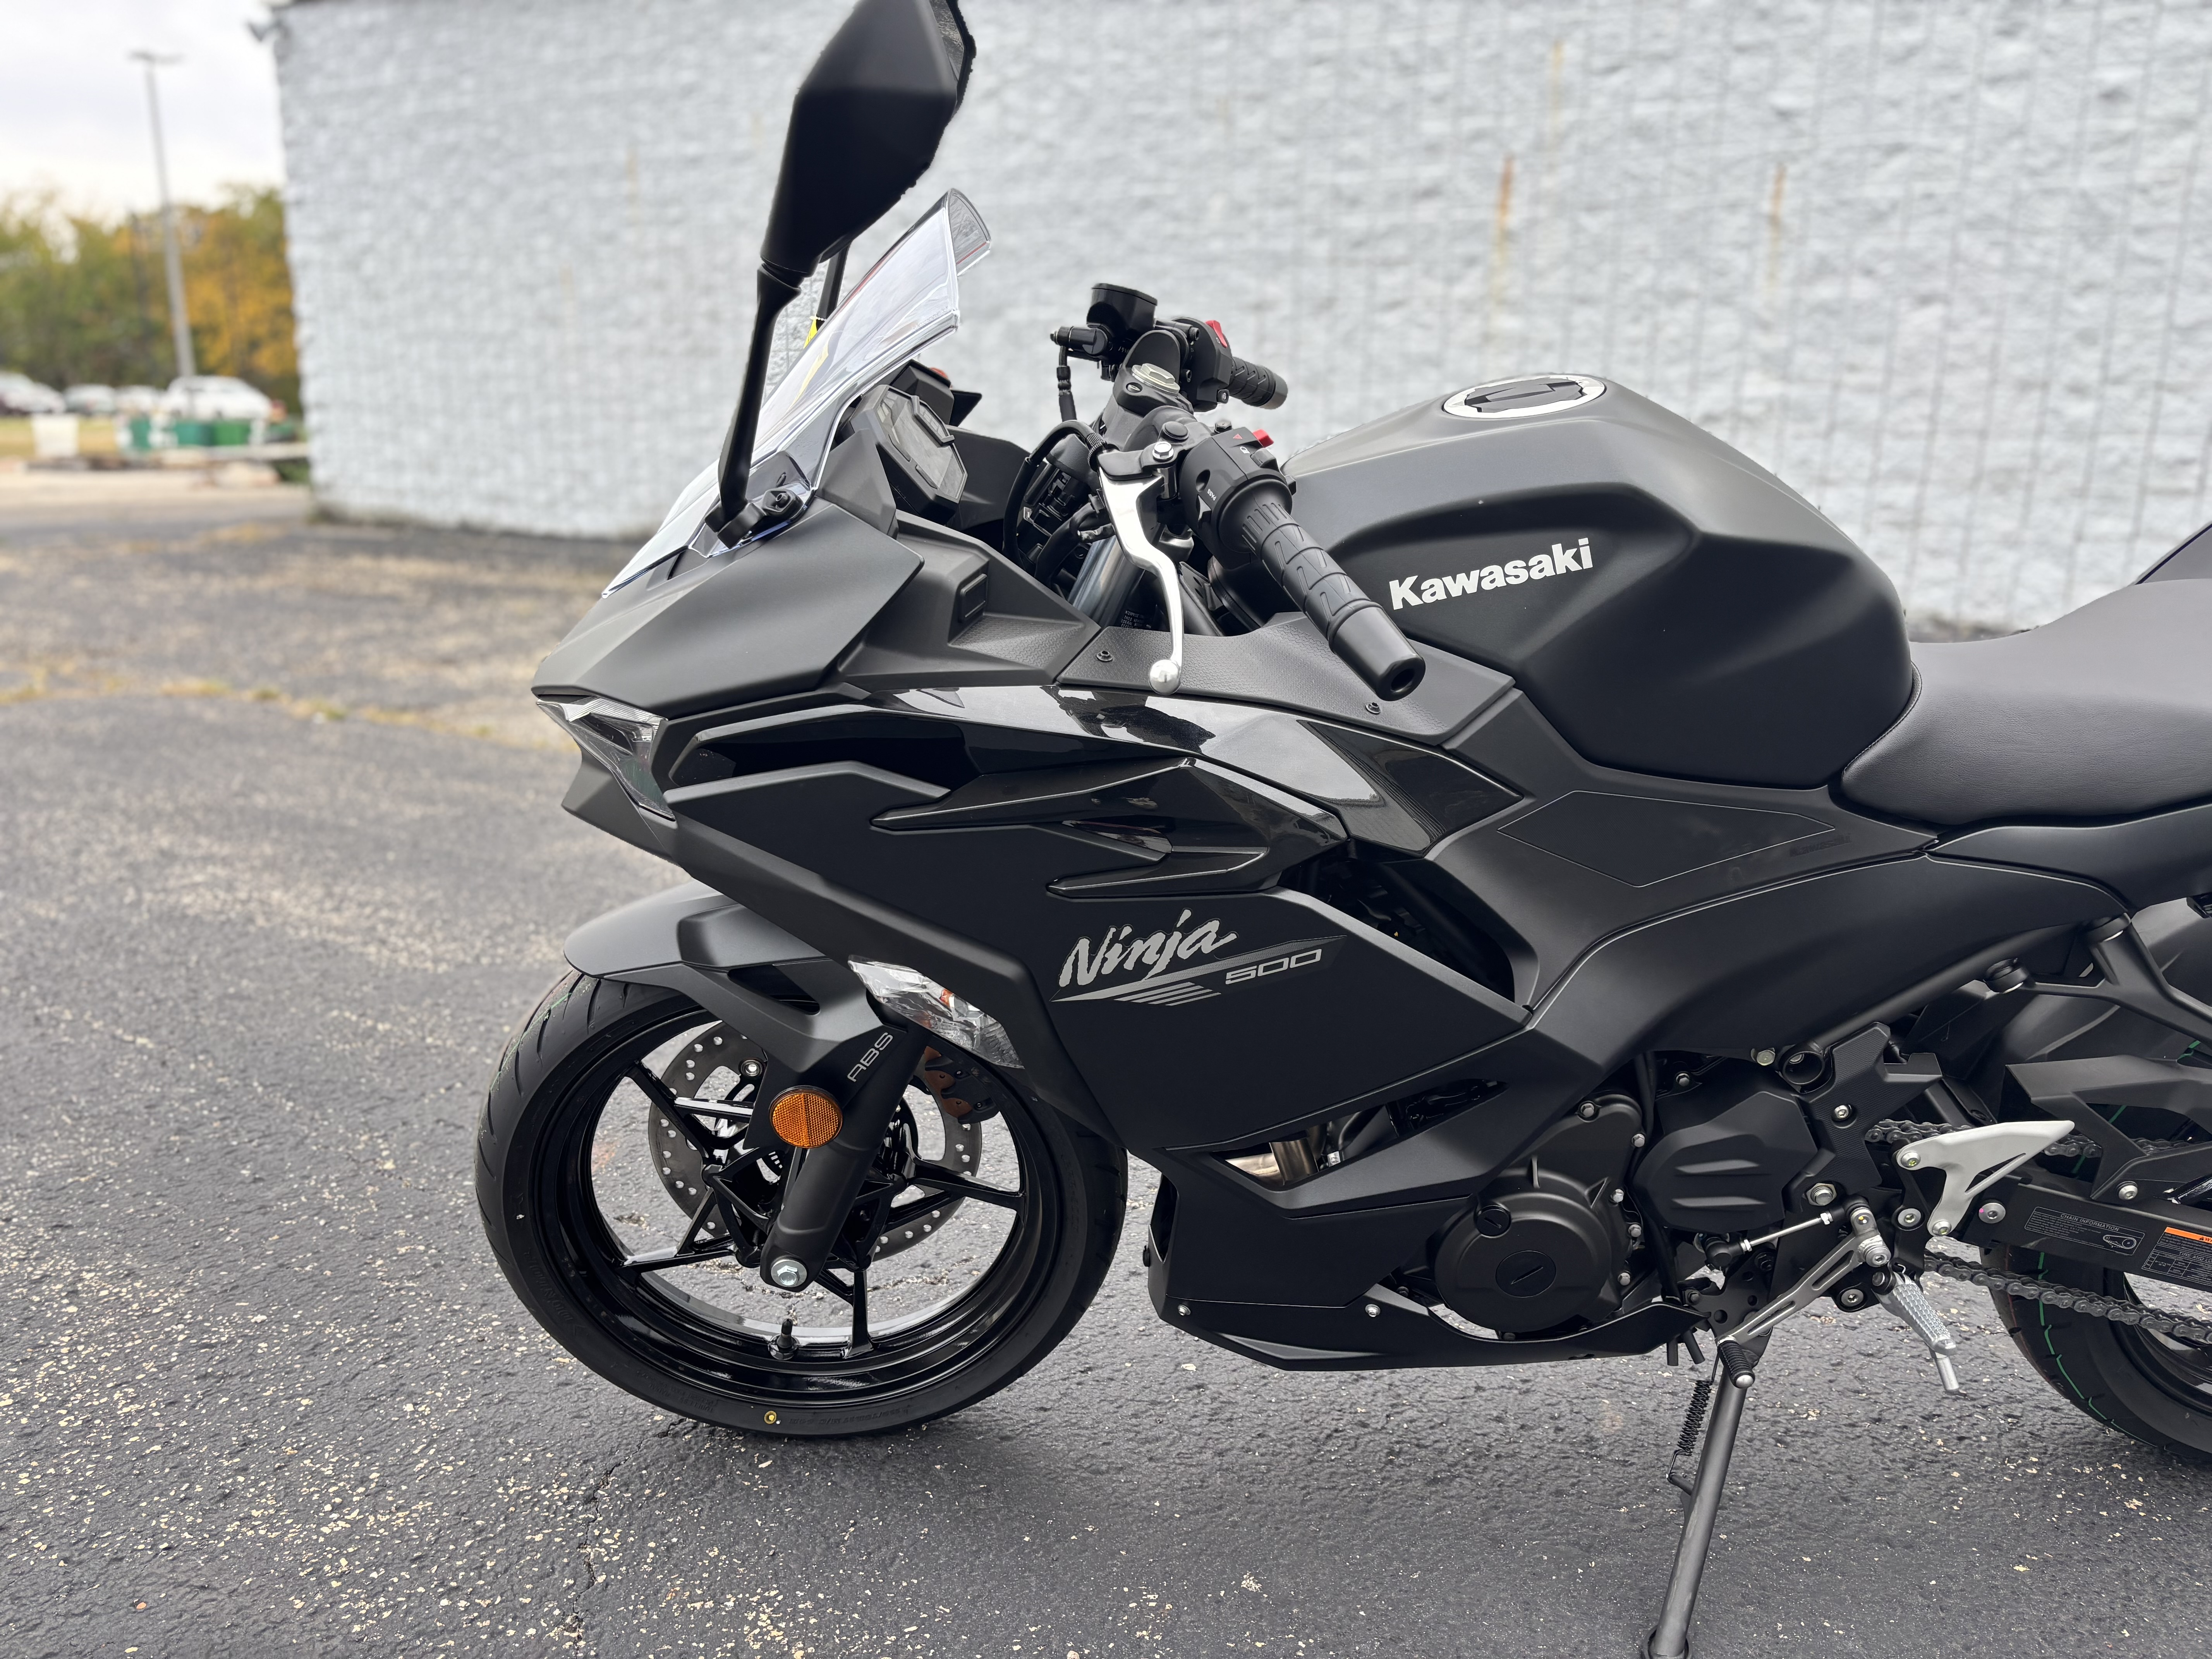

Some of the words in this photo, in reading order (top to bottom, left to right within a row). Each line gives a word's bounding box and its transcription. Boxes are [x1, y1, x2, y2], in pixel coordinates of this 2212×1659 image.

[1207, 489, 1217, 501] PASS
[1389, 537, 1593, 610] Kawasaki
[1058, 908, 1237, 987] Ninja
[1225, 948, 1322, 985] 500
[847, 1032, 893, 1082] ABS
[2080, 1218, 2119, 1231] INFORMATION
